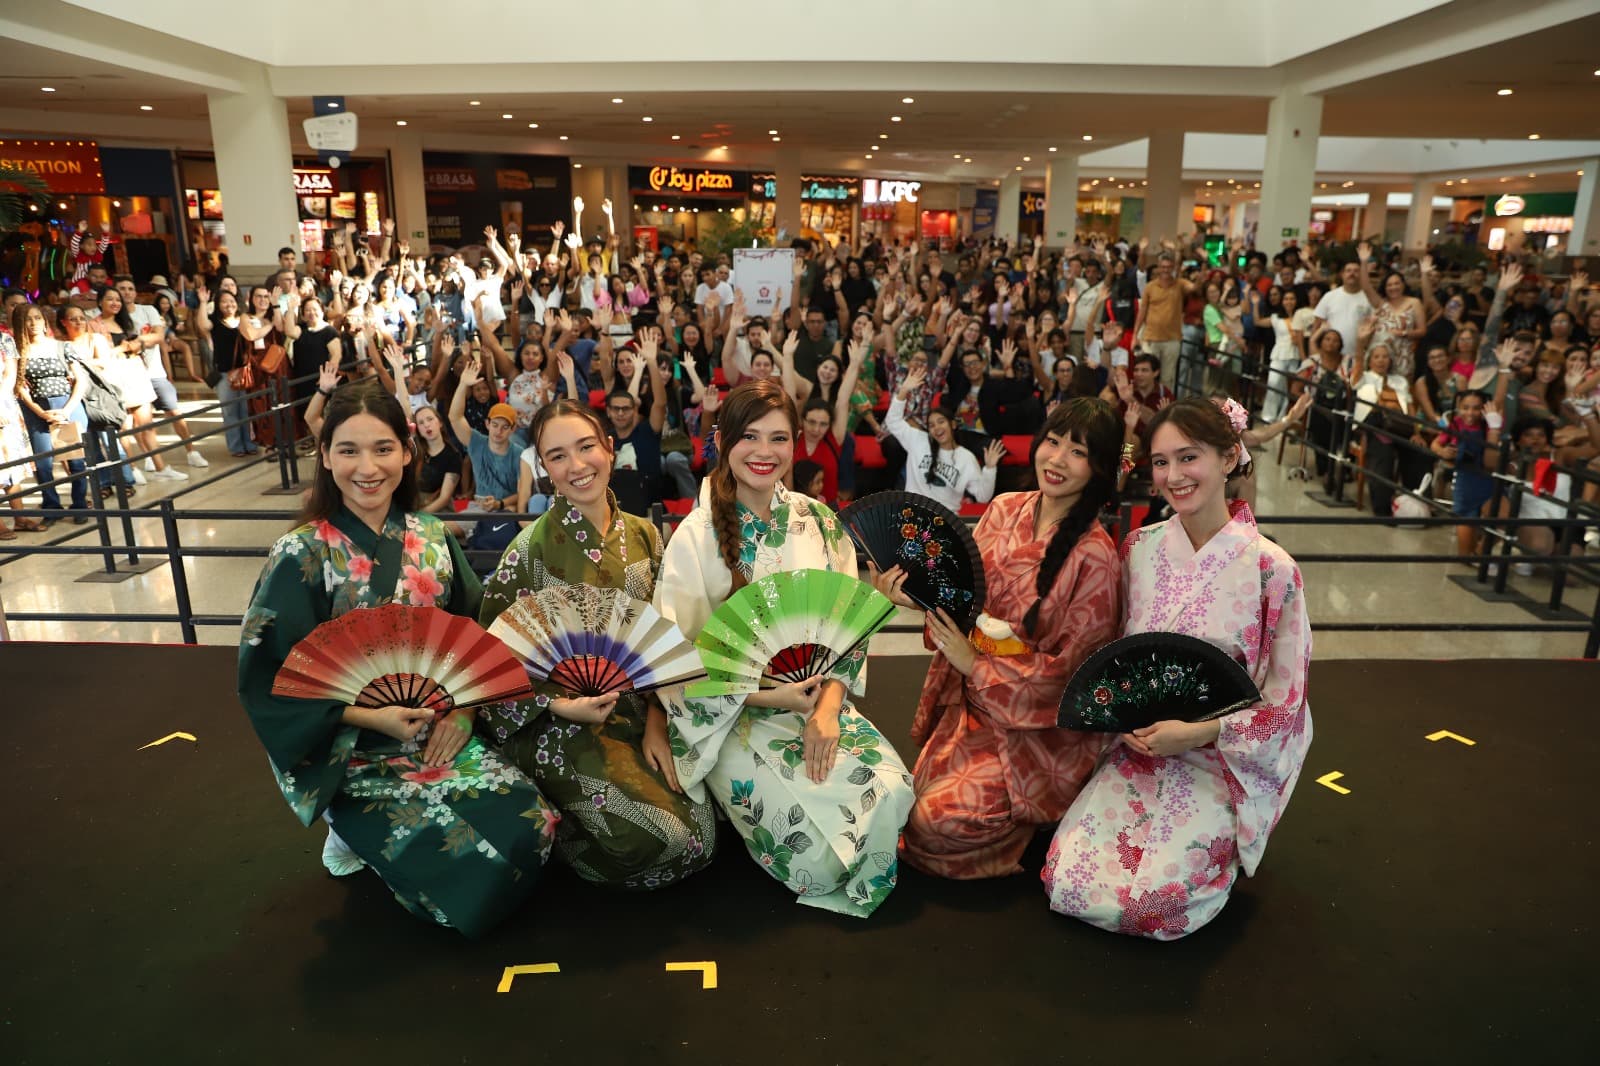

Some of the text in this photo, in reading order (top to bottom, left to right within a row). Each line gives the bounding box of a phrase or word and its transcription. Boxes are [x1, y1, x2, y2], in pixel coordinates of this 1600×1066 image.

[0, 160, 82, 174] STATION
[292, 173, 333, 189] RASA
[436, 173, 475, 186] BRASA
[695, 169, 733, 192] pizza
[879, 180, 921, 203] KFC
